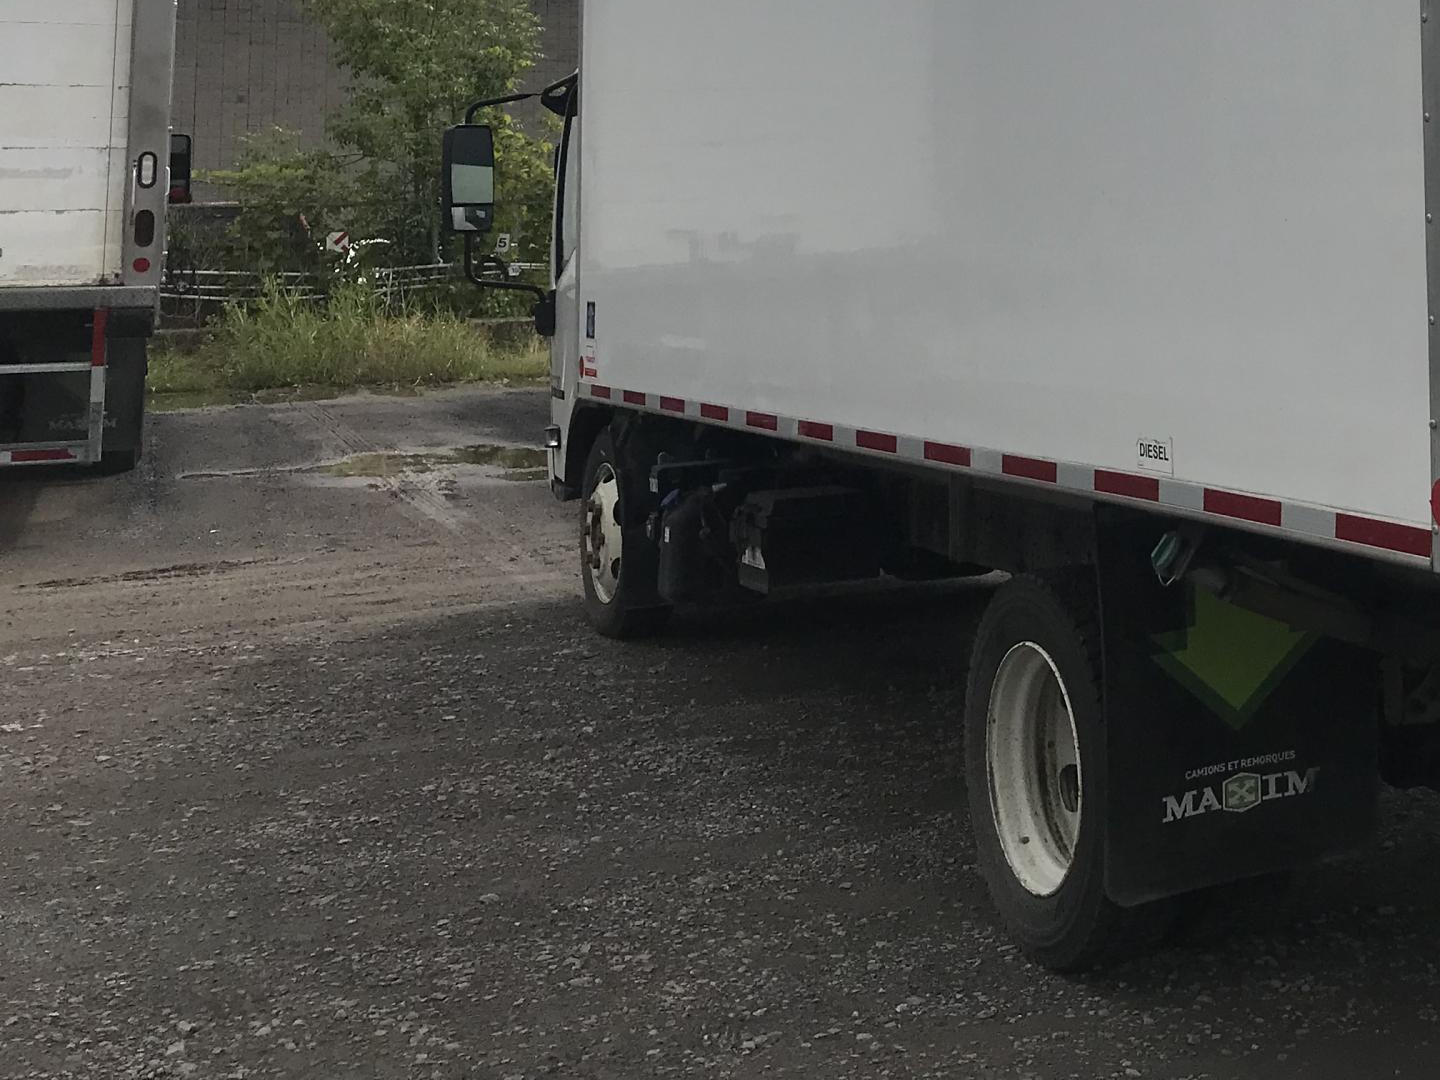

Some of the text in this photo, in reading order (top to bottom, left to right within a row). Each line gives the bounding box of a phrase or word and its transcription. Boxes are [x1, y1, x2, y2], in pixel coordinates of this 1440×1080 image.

[498, 237, 507, 248] 5
[1139, 442, 1169, 461] DIESEL
[1184, 750, 1297, 780] CAMIONS ET REMORQUES
